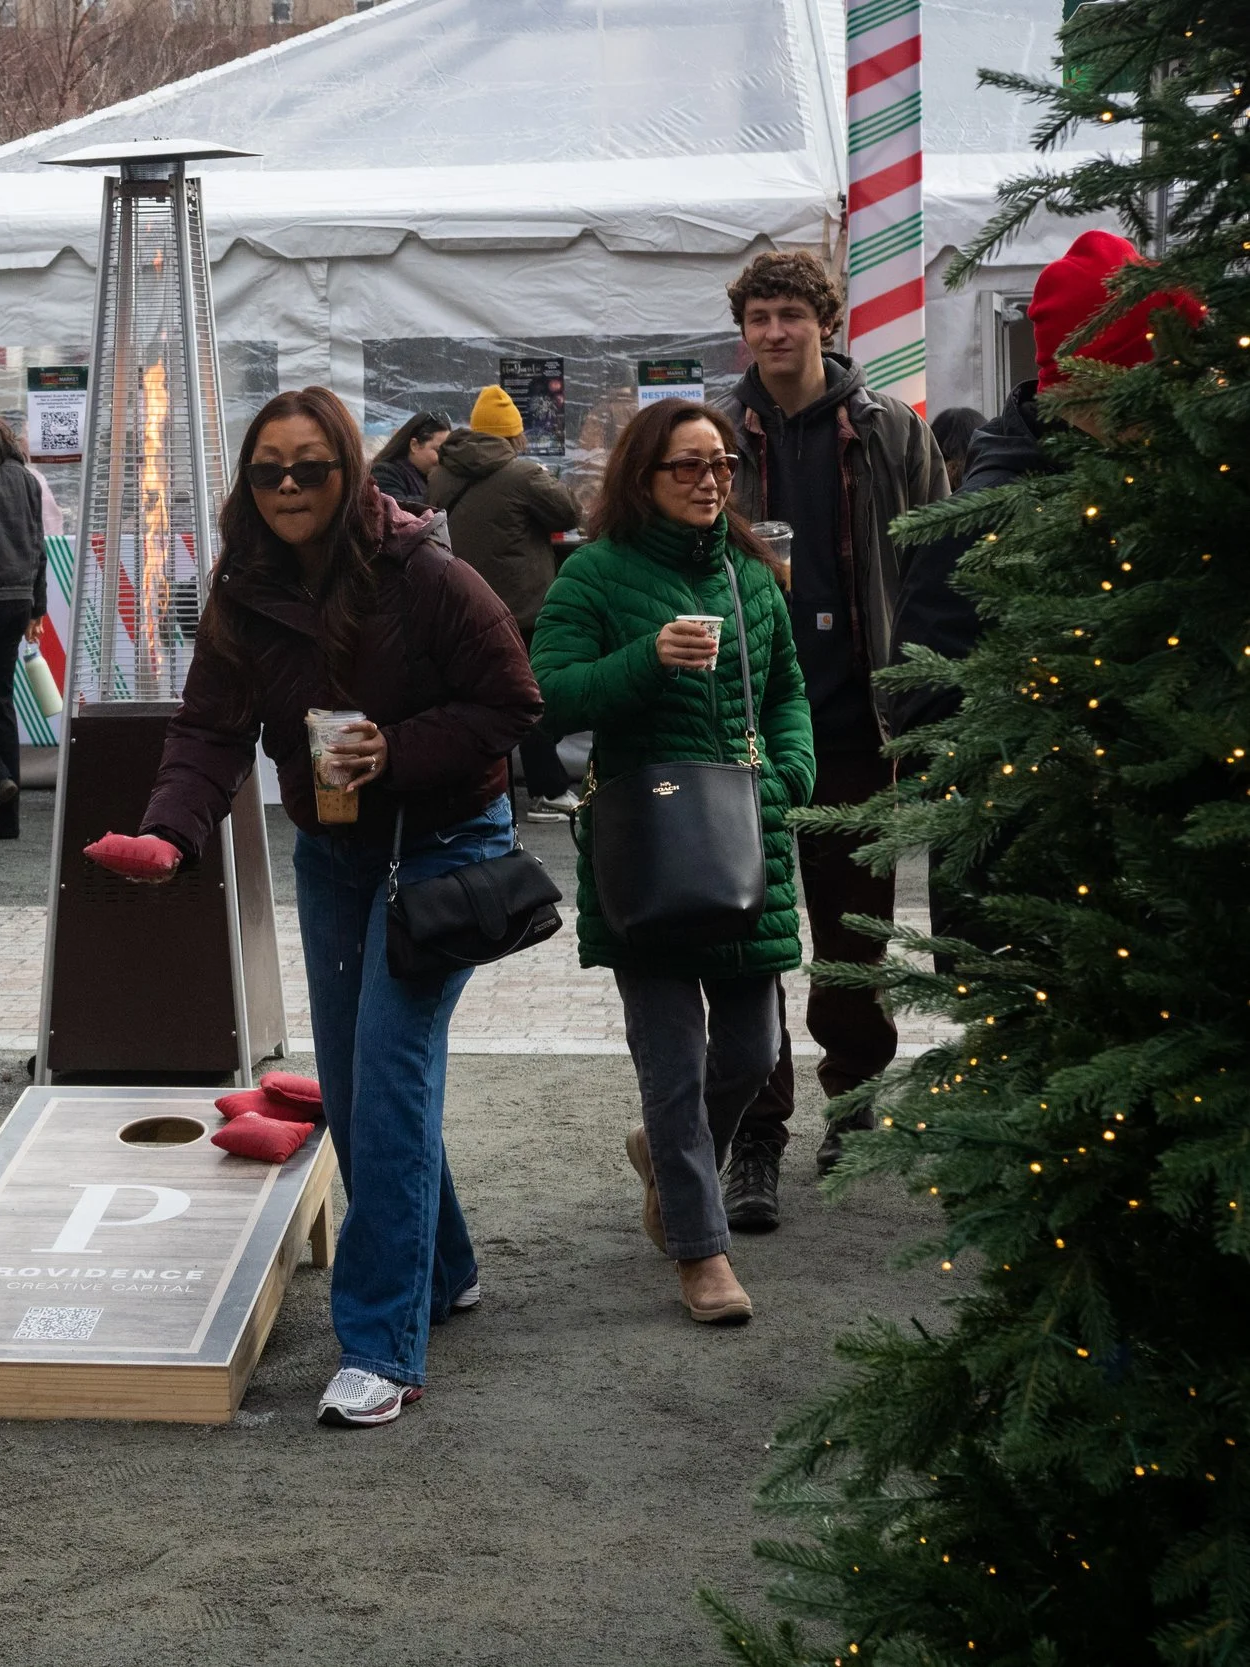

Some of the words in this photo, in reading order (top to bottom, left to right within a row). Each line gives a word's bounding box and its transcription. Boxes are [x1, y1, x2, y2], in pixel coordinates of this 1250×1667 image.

[641, 390, 702, 400] RESTROOMS
[652, 785, 680, 793] COACH
[31, 1183, 191, 1254] P
[7, 1281, 103, 1292] CREATIVE
[112, 1283, 195, 1293] CAPITAL
